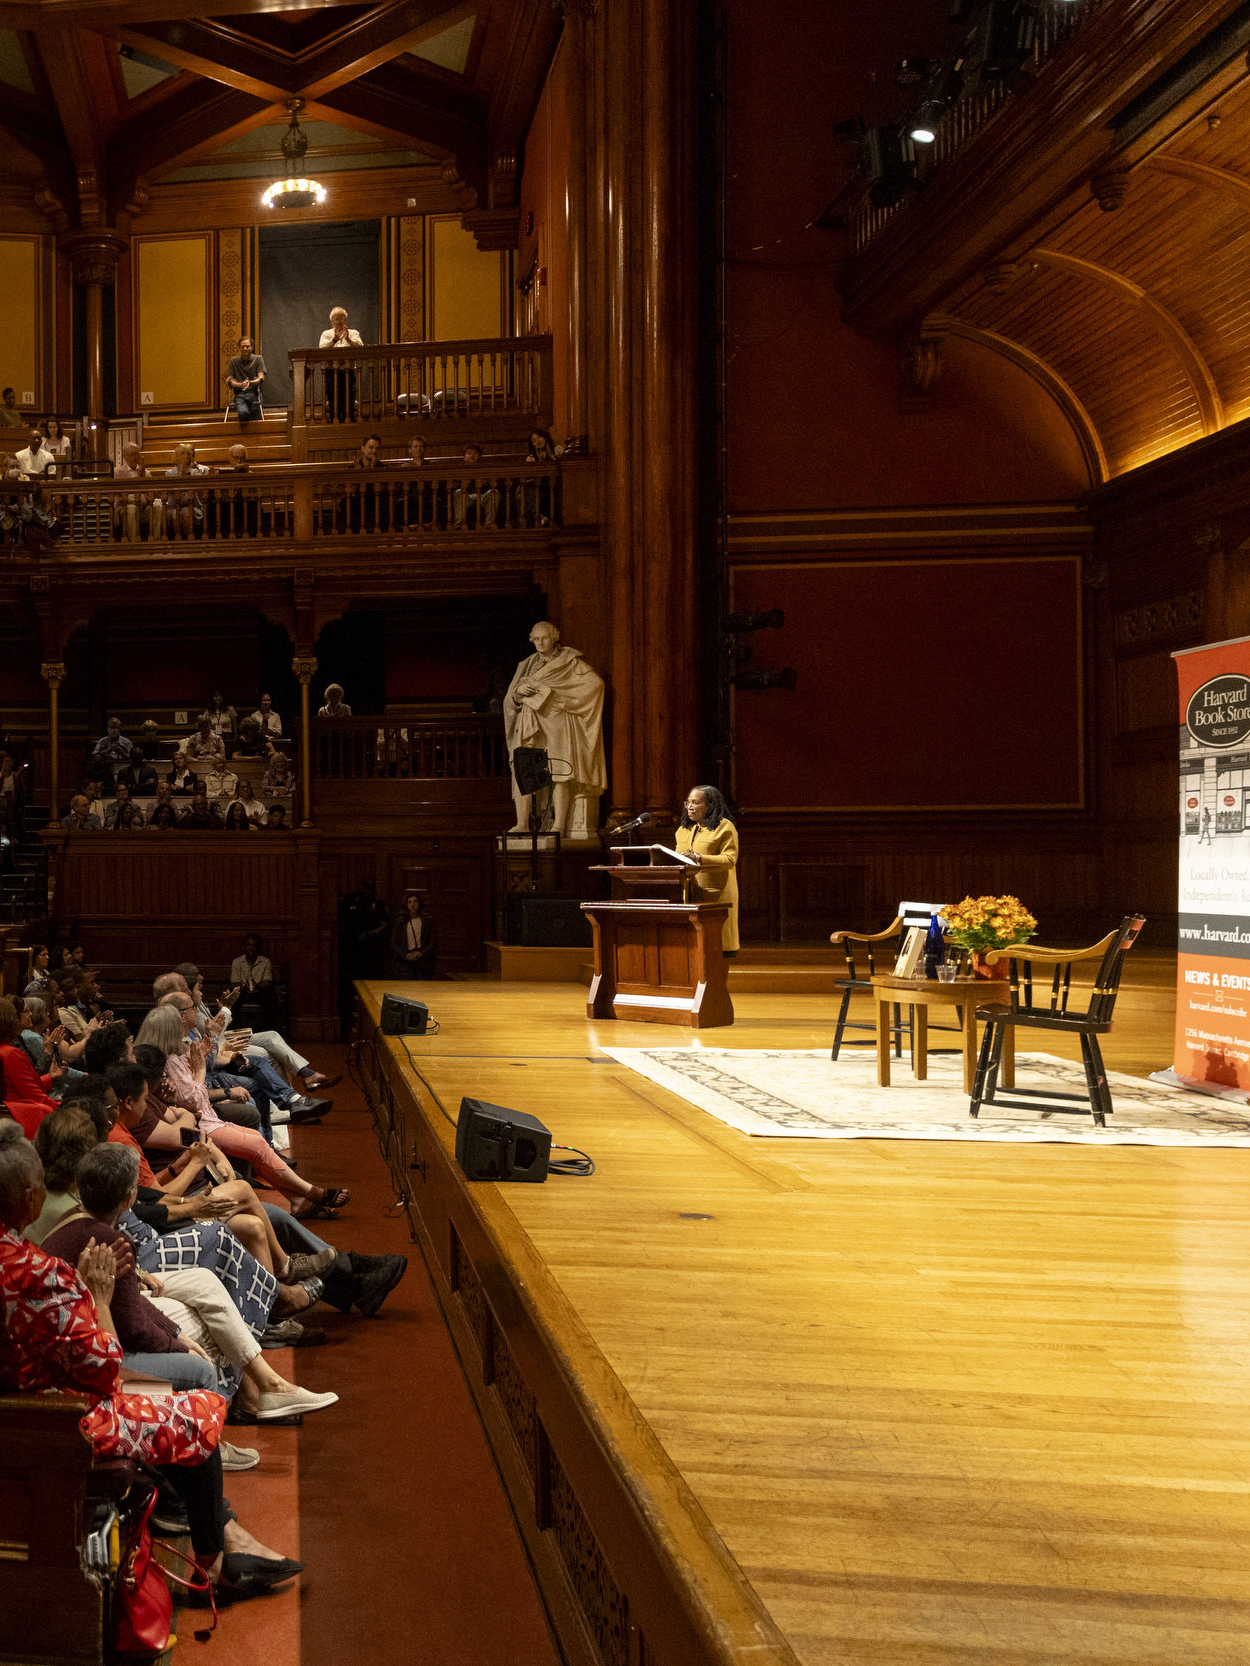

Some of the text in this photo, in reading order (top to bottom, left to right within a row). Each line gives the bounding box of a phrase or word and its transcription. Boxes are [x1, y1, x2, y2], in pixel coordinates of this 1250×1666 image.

[25, 393, 32, 402] B
[144, 394, 151, 402] A
[1203, 684, 1247, 707] Harvard
[177, 713, 185, 722] A
[1194, 704, 1250, 726] Book Store
[1212, 727, 1227, 737] SINCE
[1190, 867, 1218, 885] Locally
[1183, 887, 1238, 906] Independently
[1184, 970, 1211, 986] NEWS
[1212, 973, 1220, 987] &
[1189, 999, 1248, 1018] harvard.com/subscribe
[1185, 1027, 1198, 1038] 1256
[1198, 1029, 1233, 1045] Massachusetts
[1186, 1040, 1204, 1052] Harvard
